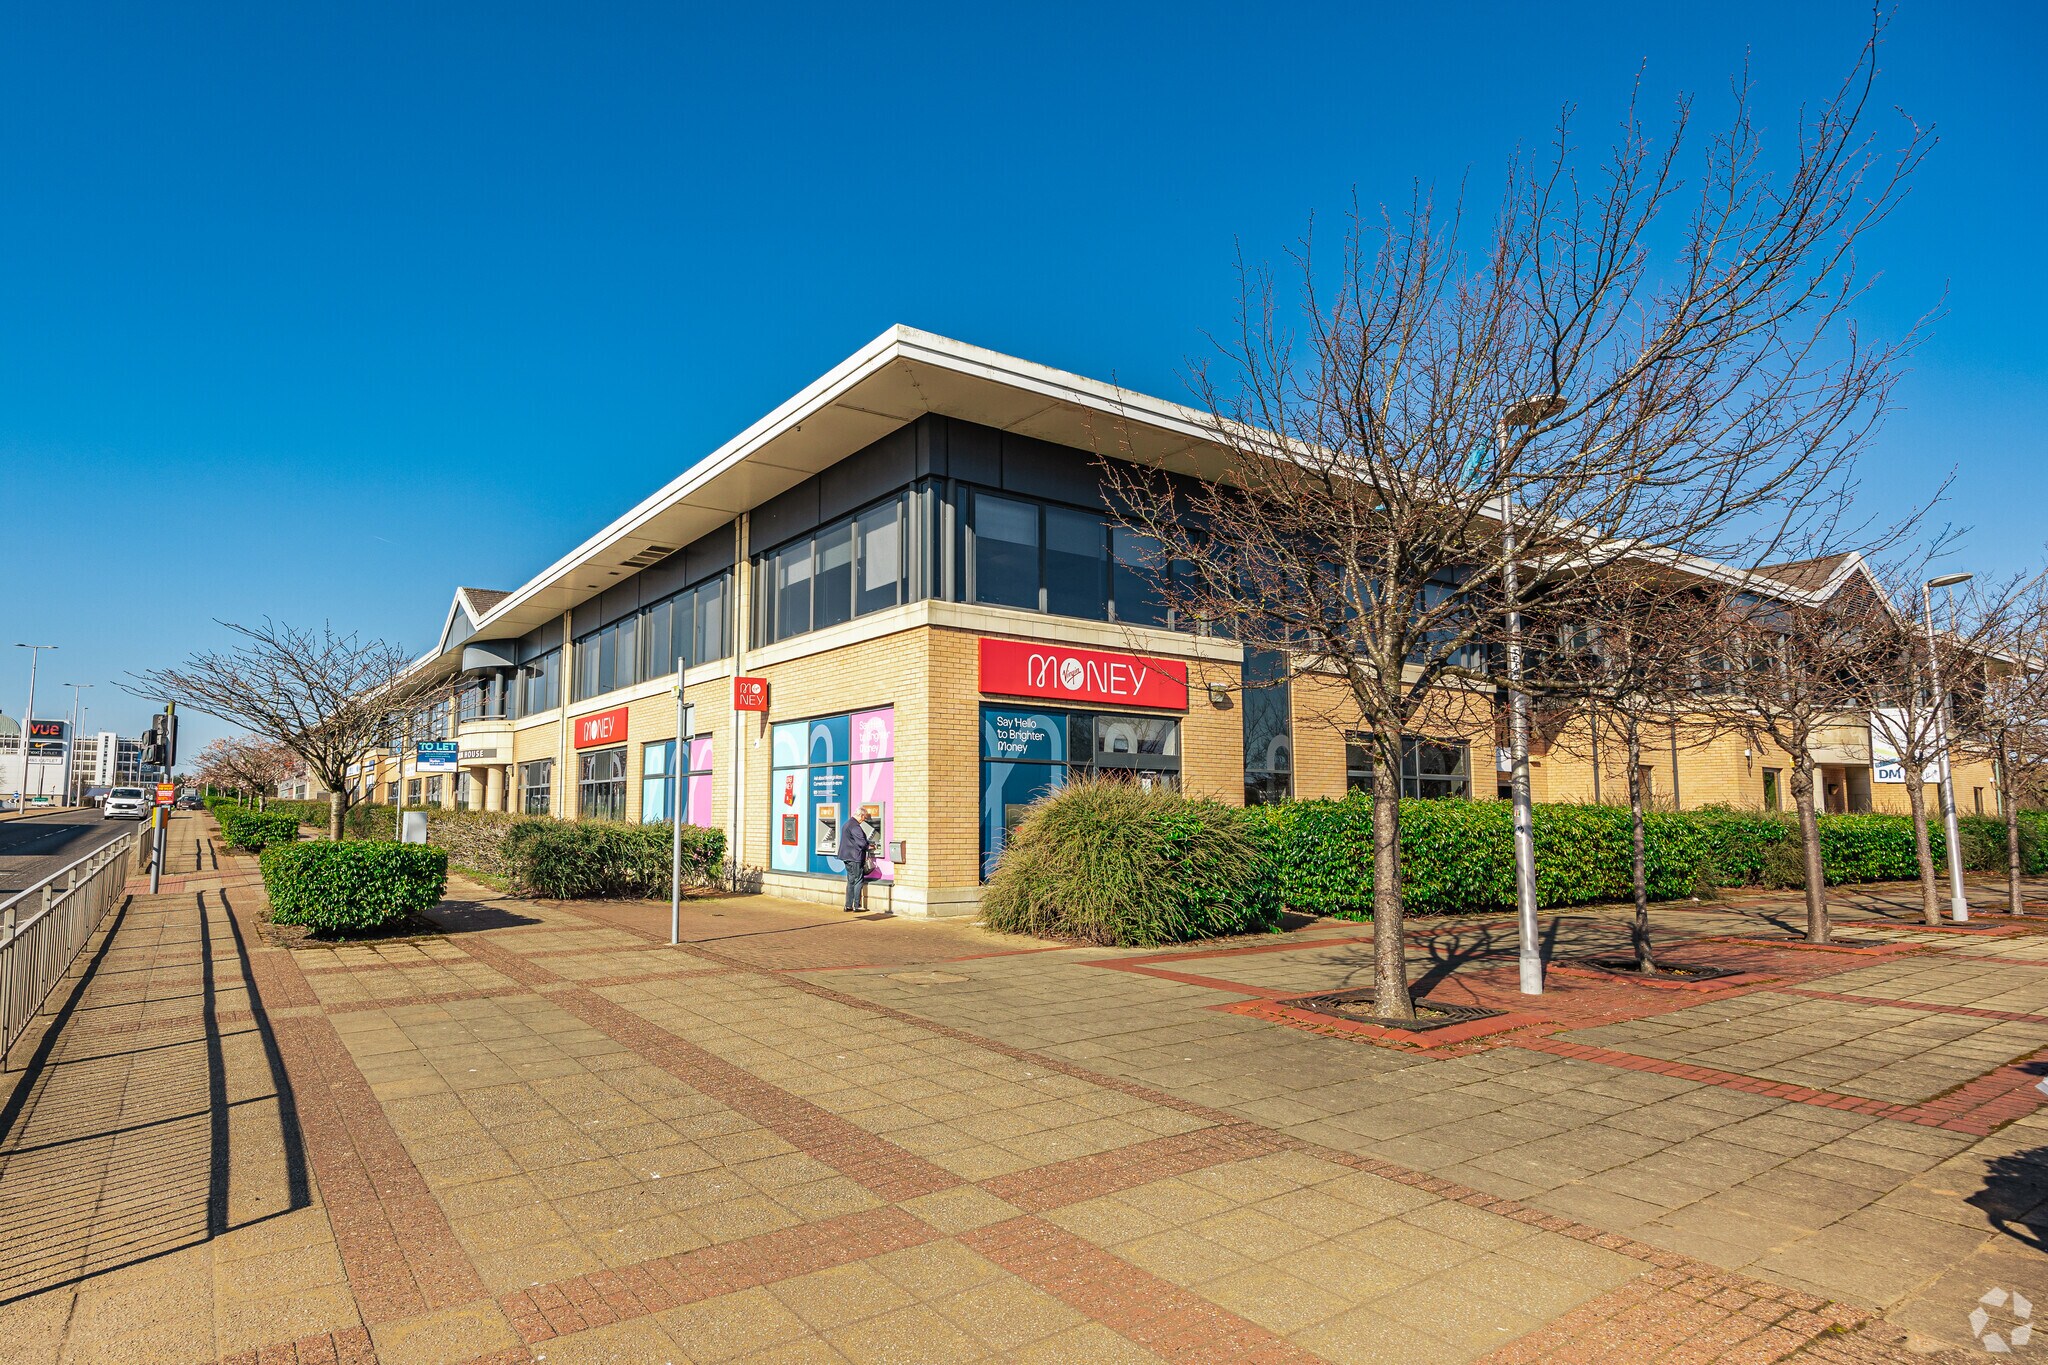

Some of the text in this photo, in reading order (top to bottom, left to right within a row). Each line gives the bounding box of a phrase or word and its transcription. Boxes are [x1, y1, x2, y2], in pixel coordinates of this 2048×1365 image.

[1028, 654, 1147, 695] MONEY
[1061, 662, 1082, 685] Virgin
[584, 716, 614, 741] MONEY
[996, 716, 1037, 729] Say Hello
[997, 729, 1045, 742] to Brighter
[464, 749, 484, 758] HOUSE
[997, 740, 1028, 754] Money
